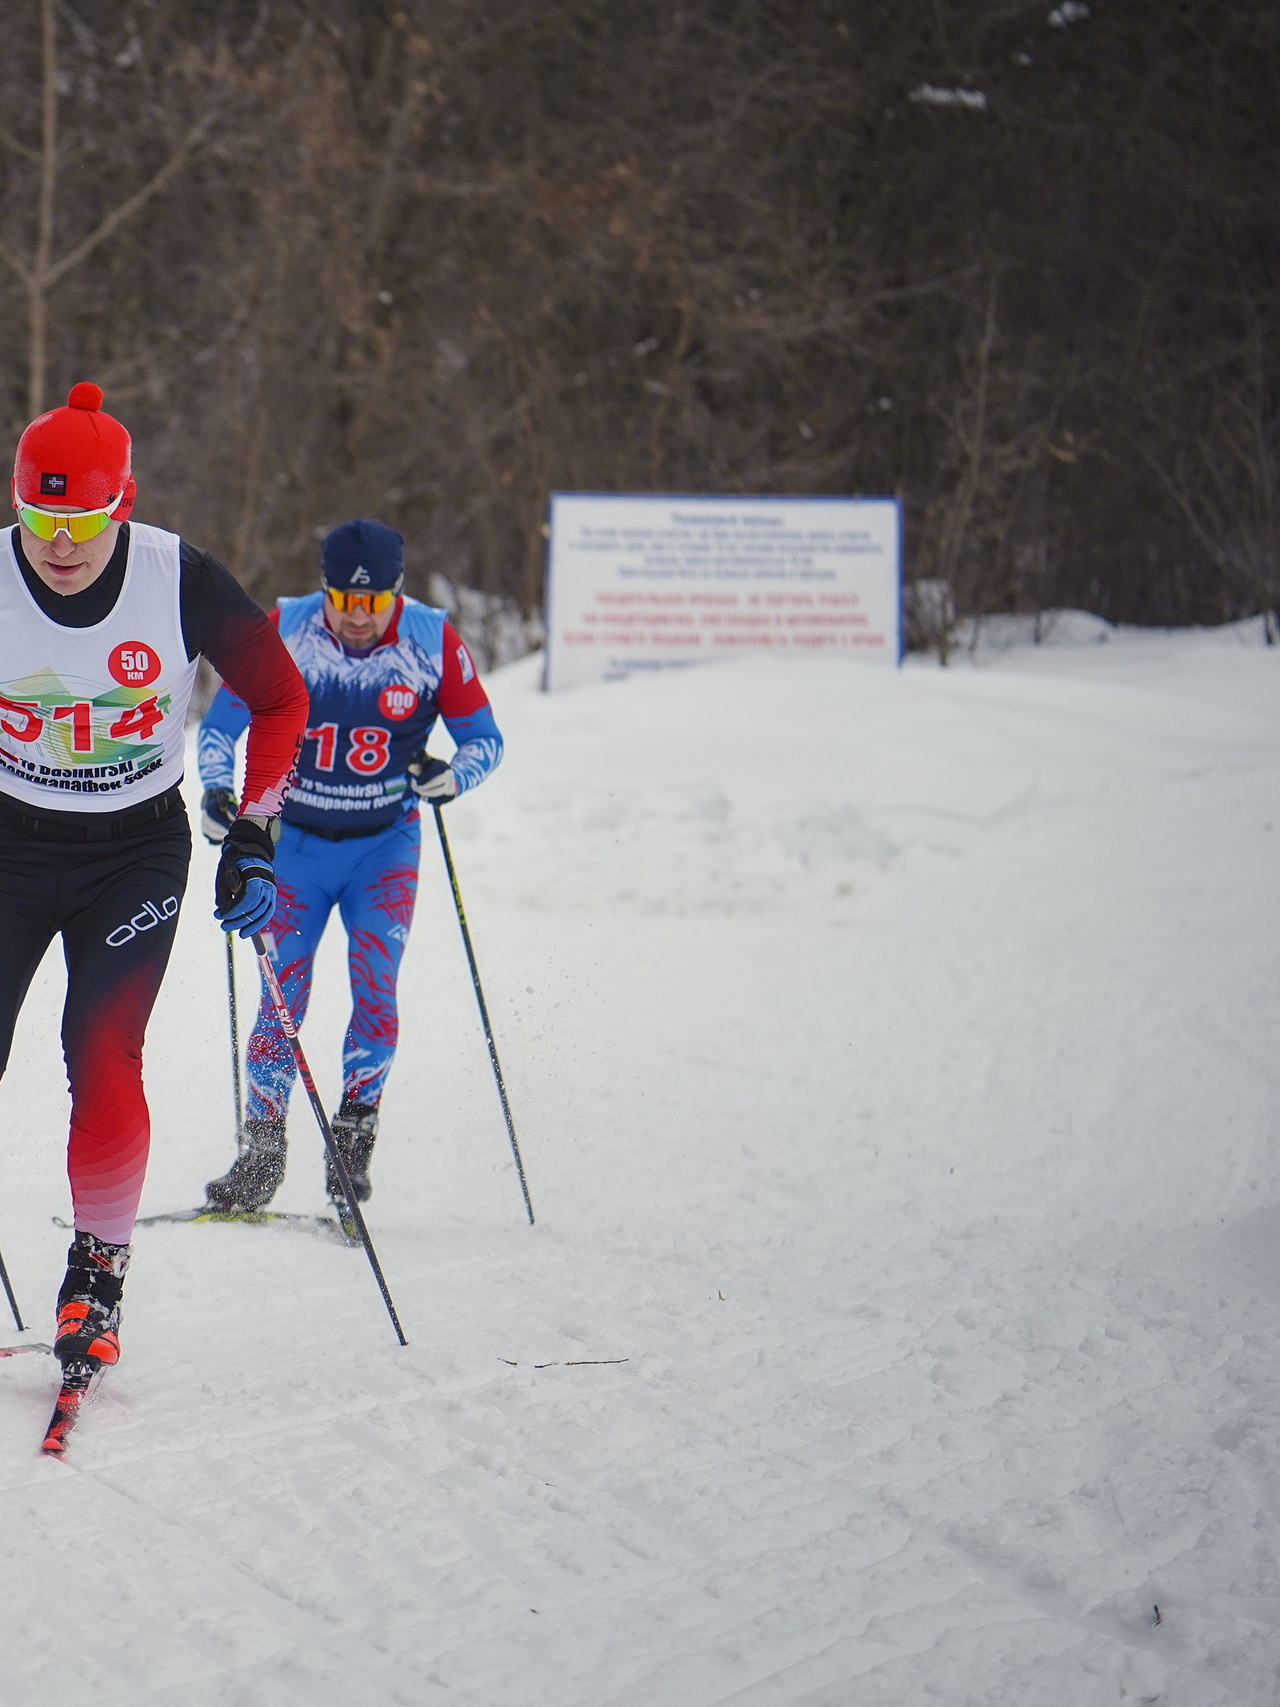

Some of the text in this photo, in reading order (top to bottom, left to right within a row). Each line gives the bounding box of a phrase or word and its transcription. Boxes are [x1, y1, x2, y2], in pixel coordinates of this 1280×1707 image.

[120, 650, 149, 671] 50
[385, 689, 415, 709] 100
[305, 722, 392, 777] 18
[105, 895, 179, 948] odlo
